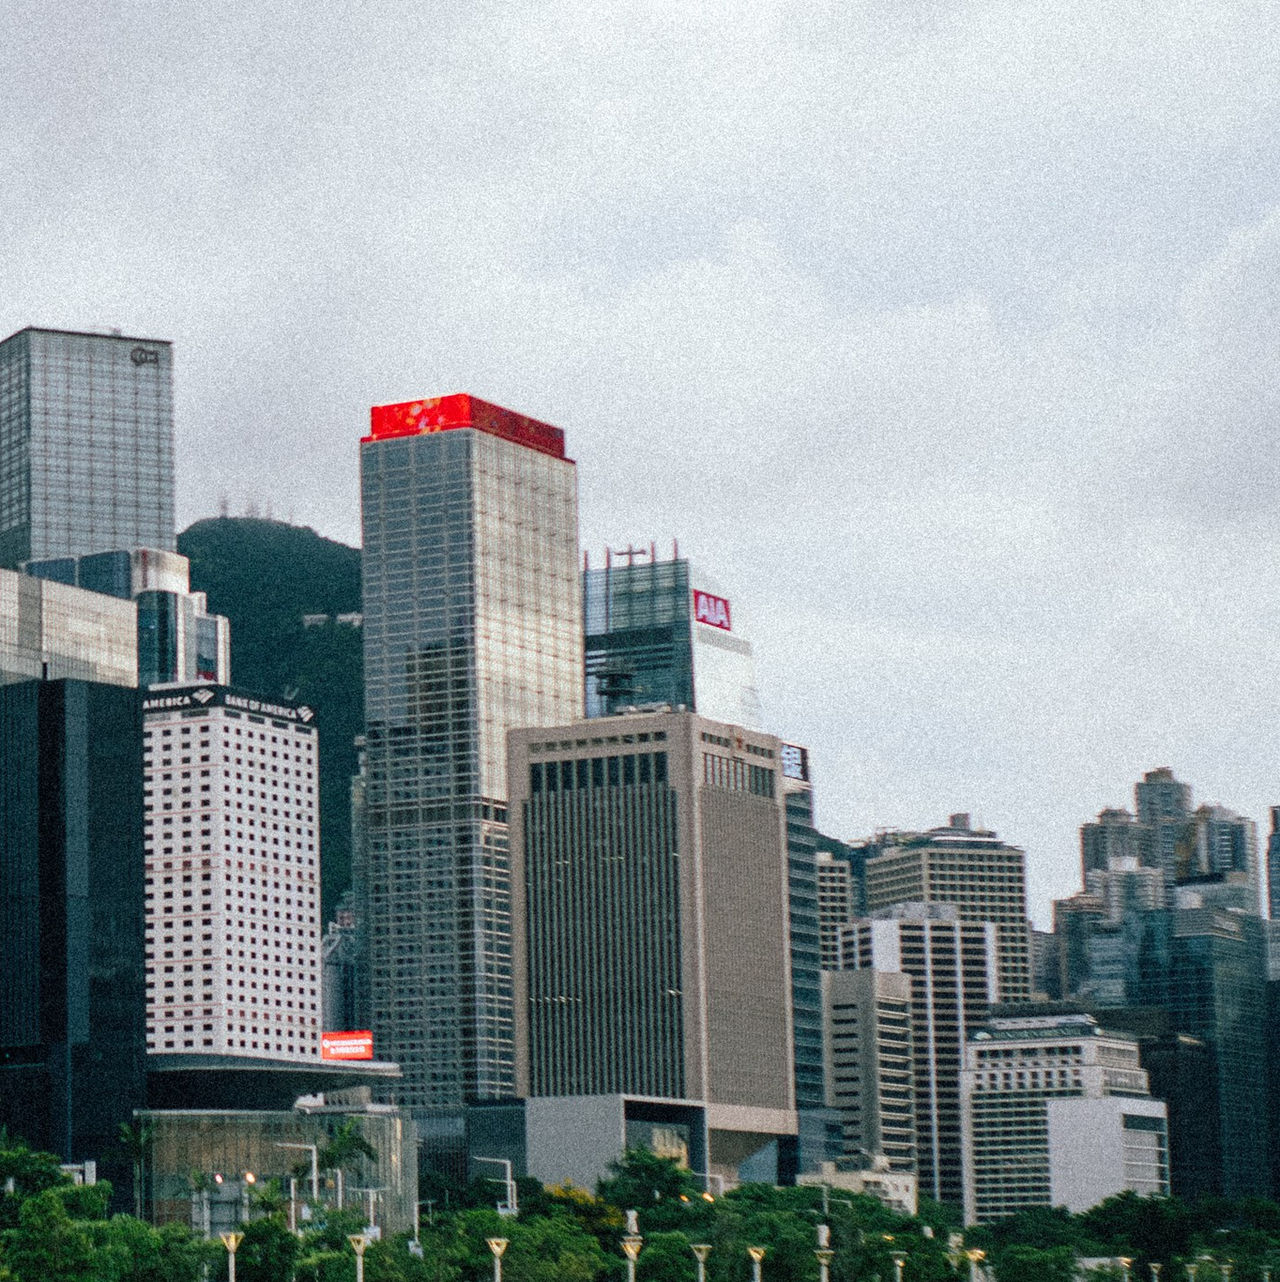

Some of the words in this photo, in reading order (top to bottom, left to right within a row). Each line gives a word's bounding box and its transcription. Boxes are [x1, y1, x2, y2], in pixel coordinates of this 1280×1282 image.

[697, 594, 729, 628] AIA
[142, 695, 191, 709] AMERICA
[224, 694, 248, 707] BANK
[261, 703, 297, 719] AMERICA
